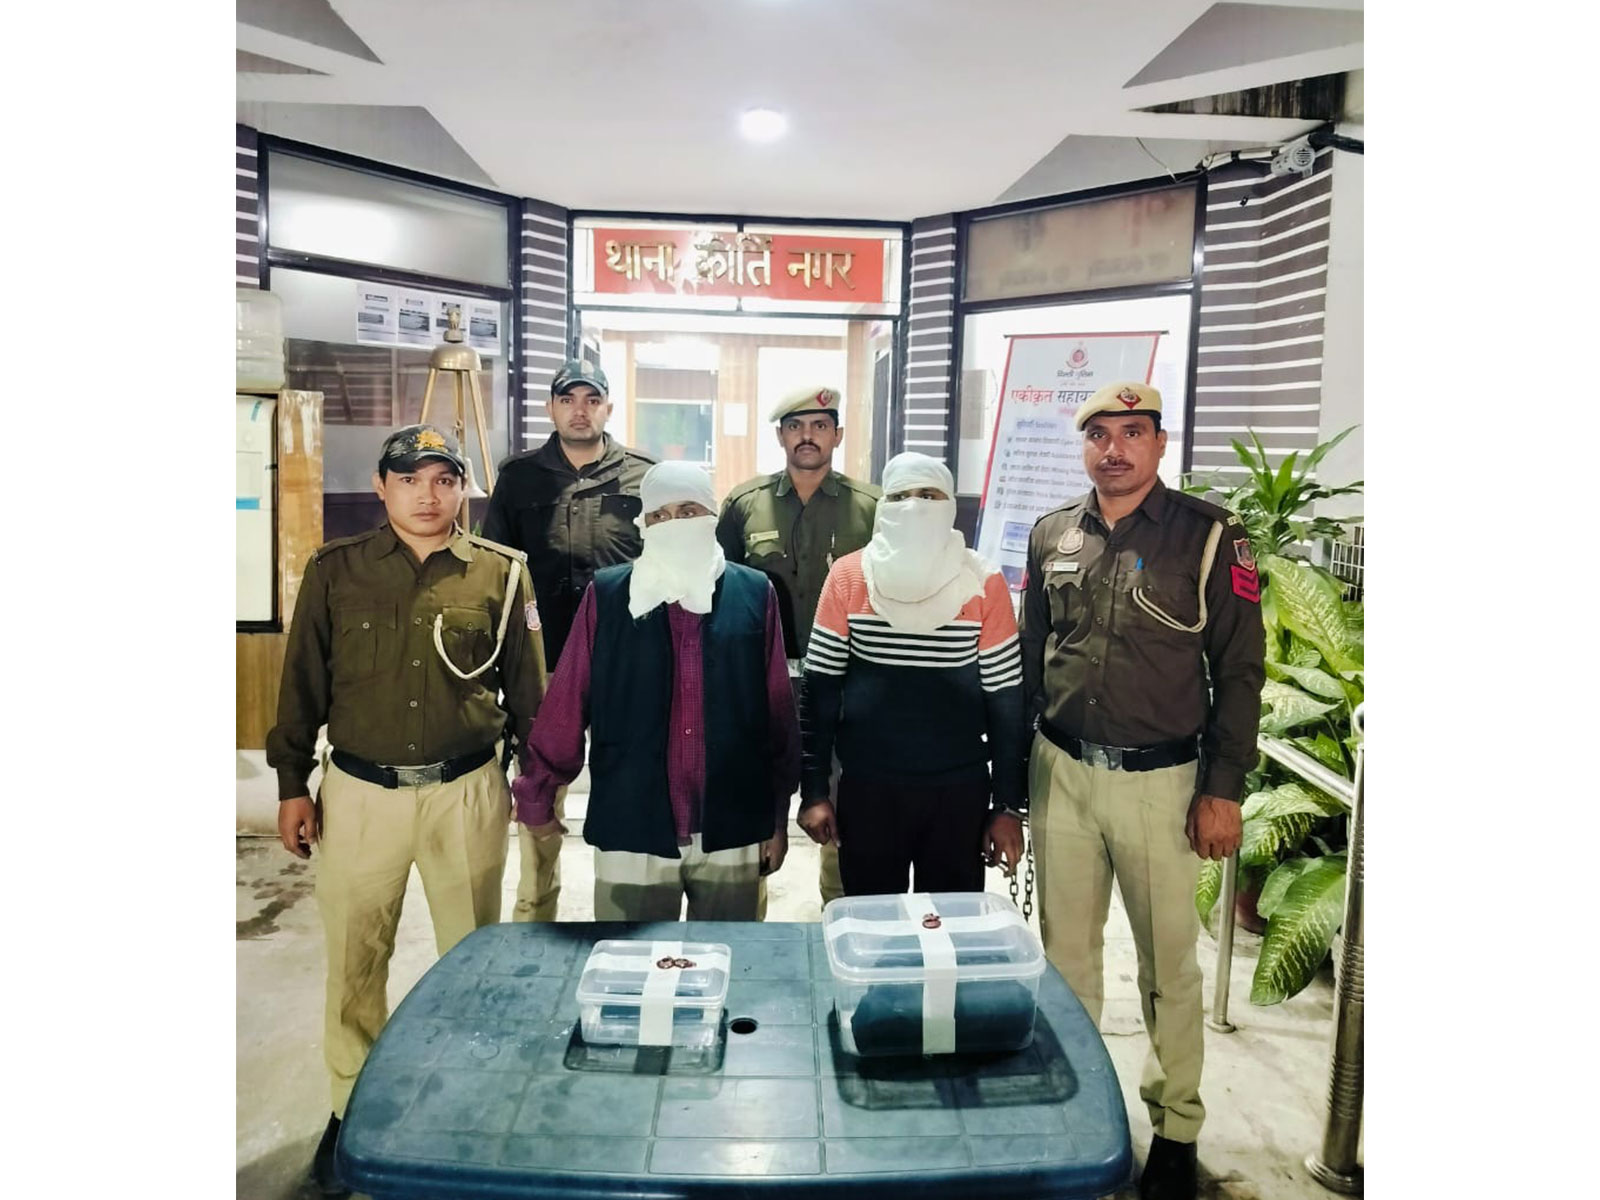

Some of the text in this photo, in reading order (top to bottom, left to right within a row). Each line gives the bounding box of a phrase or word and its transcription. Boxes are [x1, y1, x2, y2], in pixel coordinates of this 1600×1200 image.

[605, 239, 676, 281] थाना
[786, 249, 856, 290] नगर
[1011, 384, 1054, 407] एकीकृत
